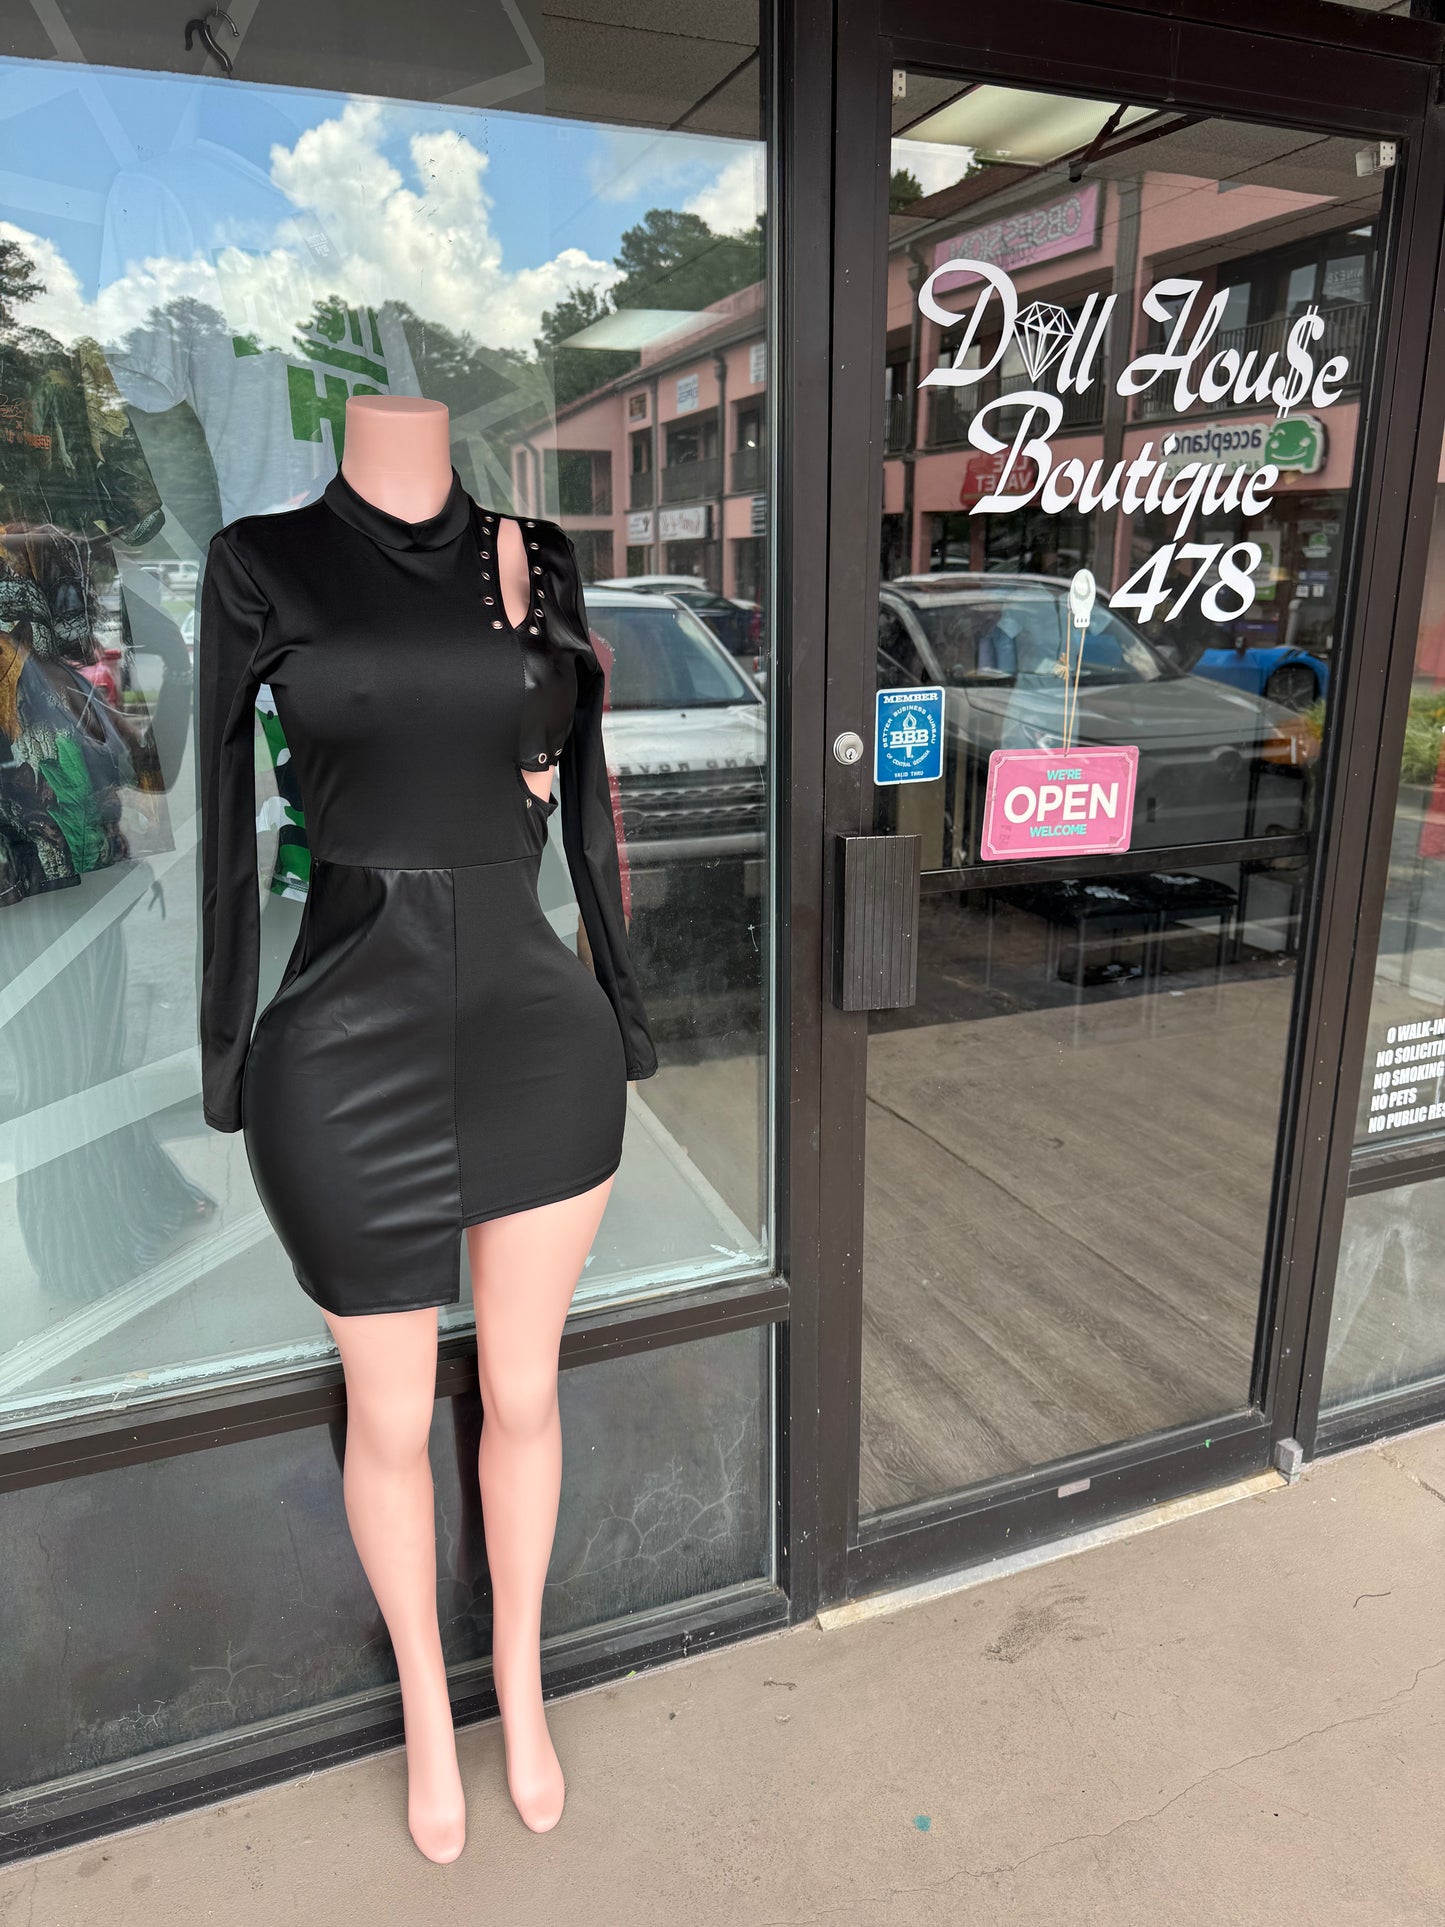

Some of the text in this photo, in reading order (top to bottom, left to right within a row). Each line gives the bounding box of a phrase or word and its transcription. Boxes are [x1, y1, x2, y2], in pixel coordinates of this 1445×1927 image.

[967, 391, 1279, 542] Boutique
[1108, 541, 1262, 624] 478
[883, 692, 939, 704] MEMBER
[882, 704, 937, 748] BETTER BUSINESS BUREAU
[889, 728, 930, 746] BBB
[892, 758, 911, 768] CENTRAL
[1047, 768, 1083, 781] WE'RE
[1003, 782, 1120, 824] OPEN
[1029, 824, 1088, 838] WELCOME
[1376, 1049, 1394, 1068] NO
[1373, 1060, 1445, 1090] NO SMOKING
[1370, 1087, 1418, 1112] NO PETS
[1368, 1115, 1386, 1134] NO
[1386, 1105, 1428, 1130] PUBLIC
